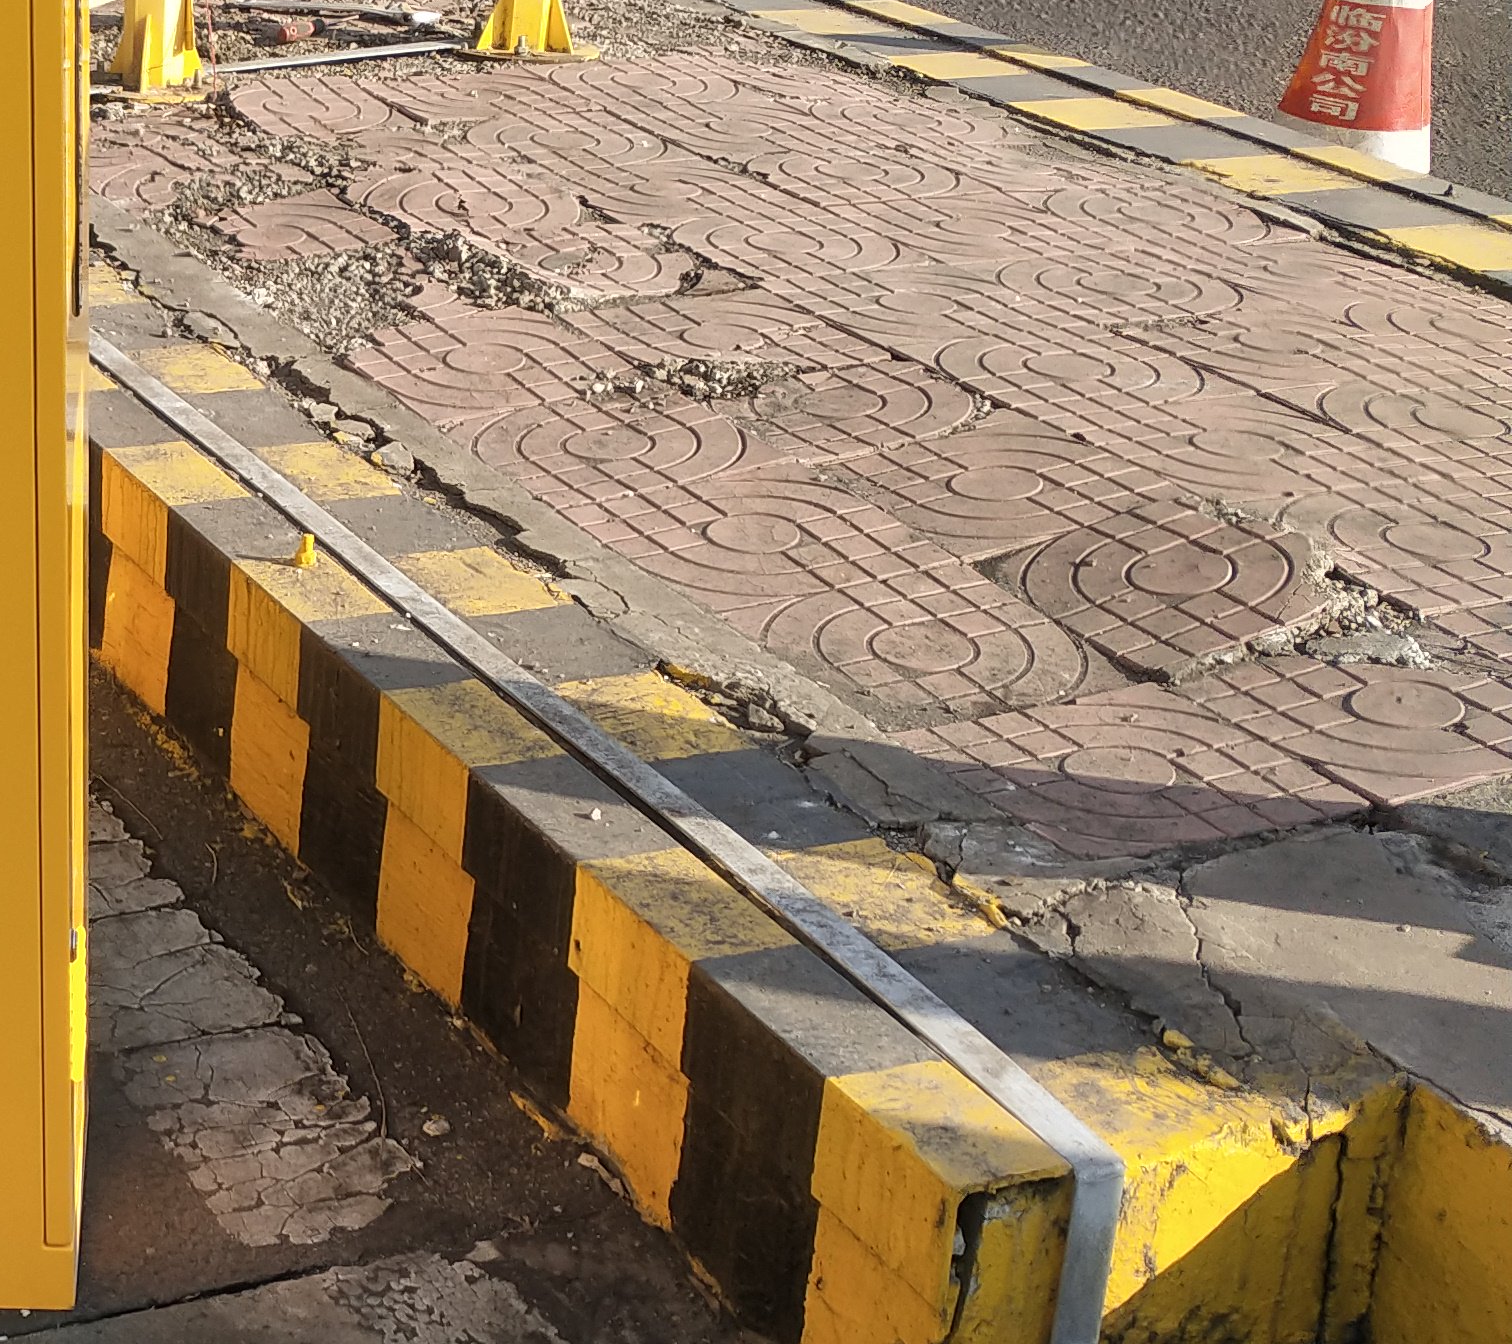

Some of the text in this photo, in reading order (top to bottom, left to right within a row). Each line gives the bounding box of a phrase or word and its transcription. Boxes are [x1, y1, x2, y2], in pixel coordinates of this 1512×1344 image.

[1309, 5, 1386, 121] 临汾南公司
